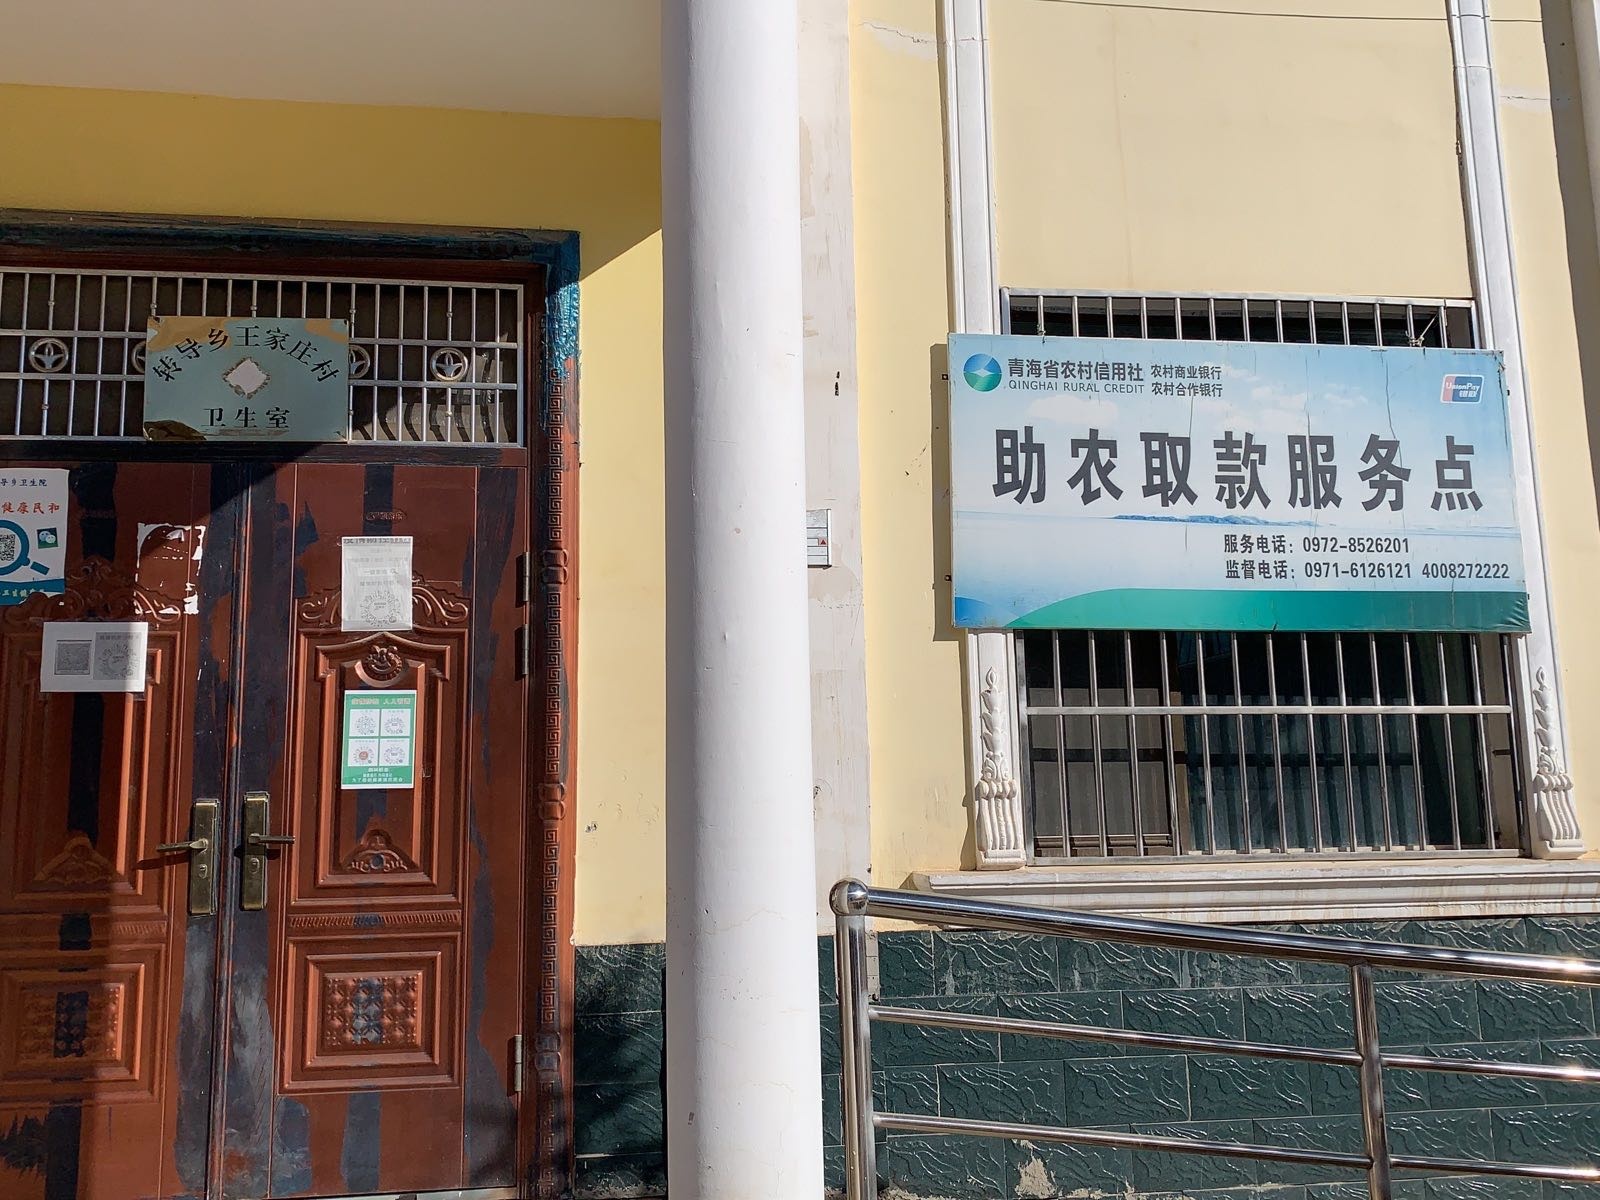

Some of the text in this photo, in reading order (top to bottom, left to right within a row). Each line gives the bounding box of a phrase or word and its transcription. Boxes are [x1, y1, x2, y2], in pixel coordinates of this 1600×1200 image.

[152, 325, 340, 382] 转导乡王家庄村
[1008, 358, 1144, 382] 青海省农村信用社
[1150, 364, 1222, 380] 农村商业银行
[1008, 379, 1145, 394] QINGHAI RURAL CREDIT
[1151, 382, 1223, 397] 农村合作银行
[201, 406, 290, 429] 卫生室
[992, 425, 1484, 512] 助农取款服务点
[2, 501, 60, 515] 健康民和
[1421, 563, 1511, 579] 4008272222
